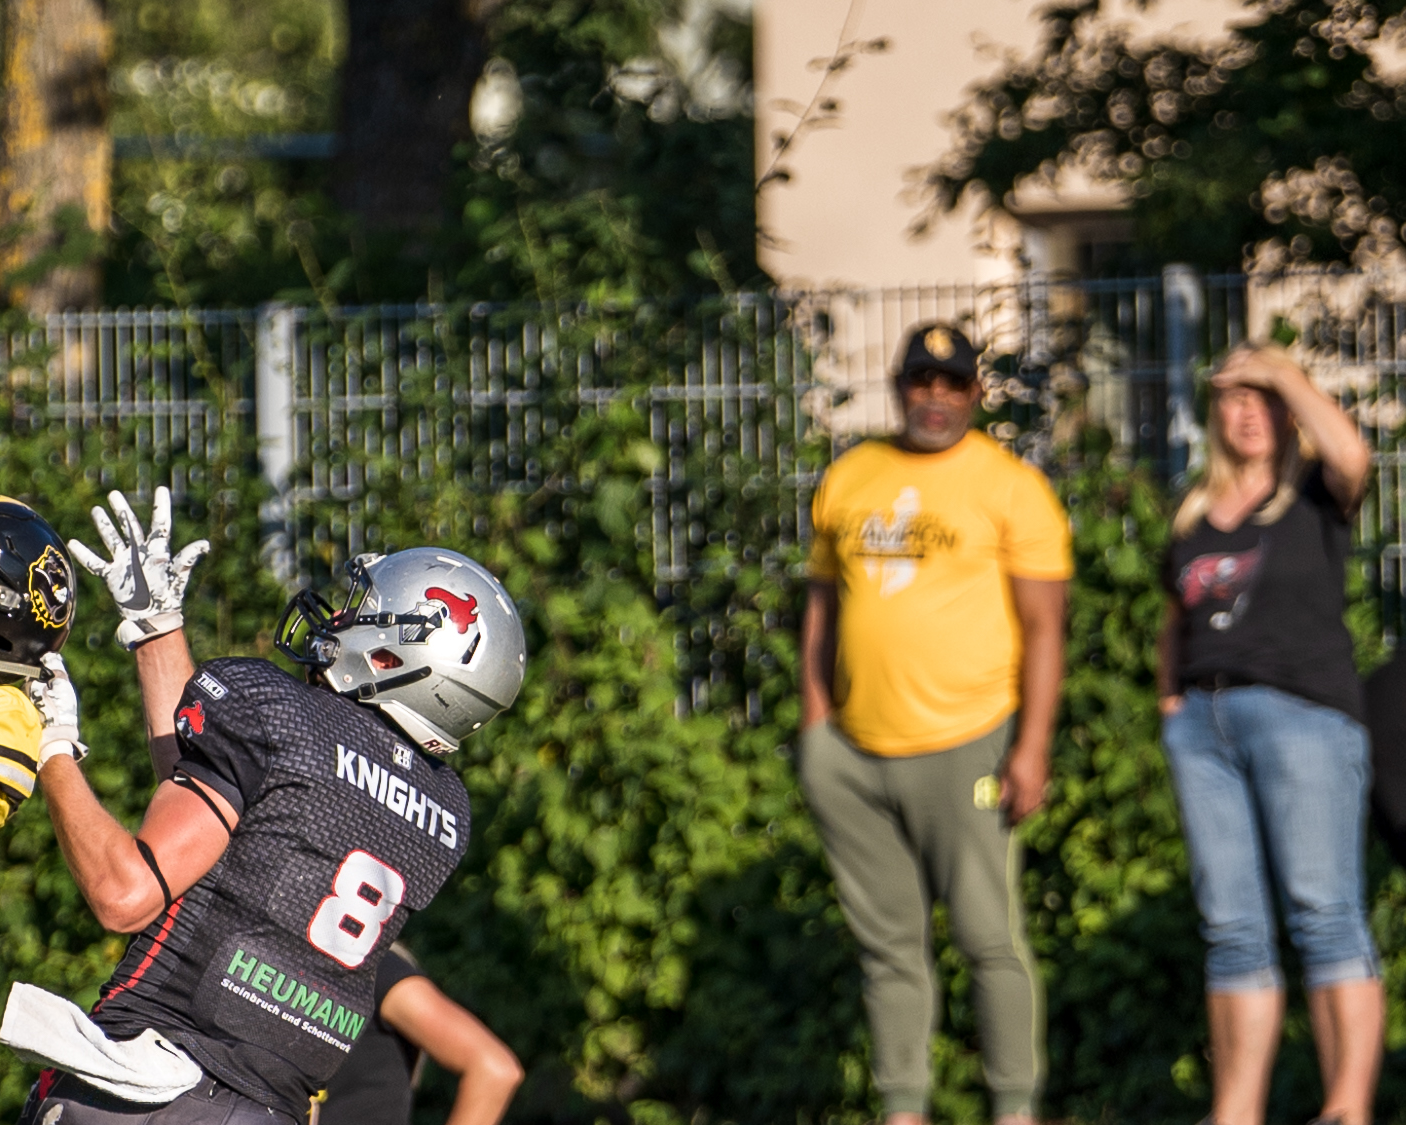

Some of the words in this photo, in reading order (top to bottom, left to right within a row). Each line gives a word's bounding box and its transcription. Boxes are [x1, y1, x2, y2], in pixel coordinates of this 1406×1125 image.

[336, 744, 457, 849] KNIGHTS
[307, 849, 406, 970] 8
[220, 978, 280, 1016] Steinbruch
[281, 1011, 302, 1027] und
[301, 1021, 351, 1054] Schotterwerk
[227, 949, 365, 1041] HEUMANN
